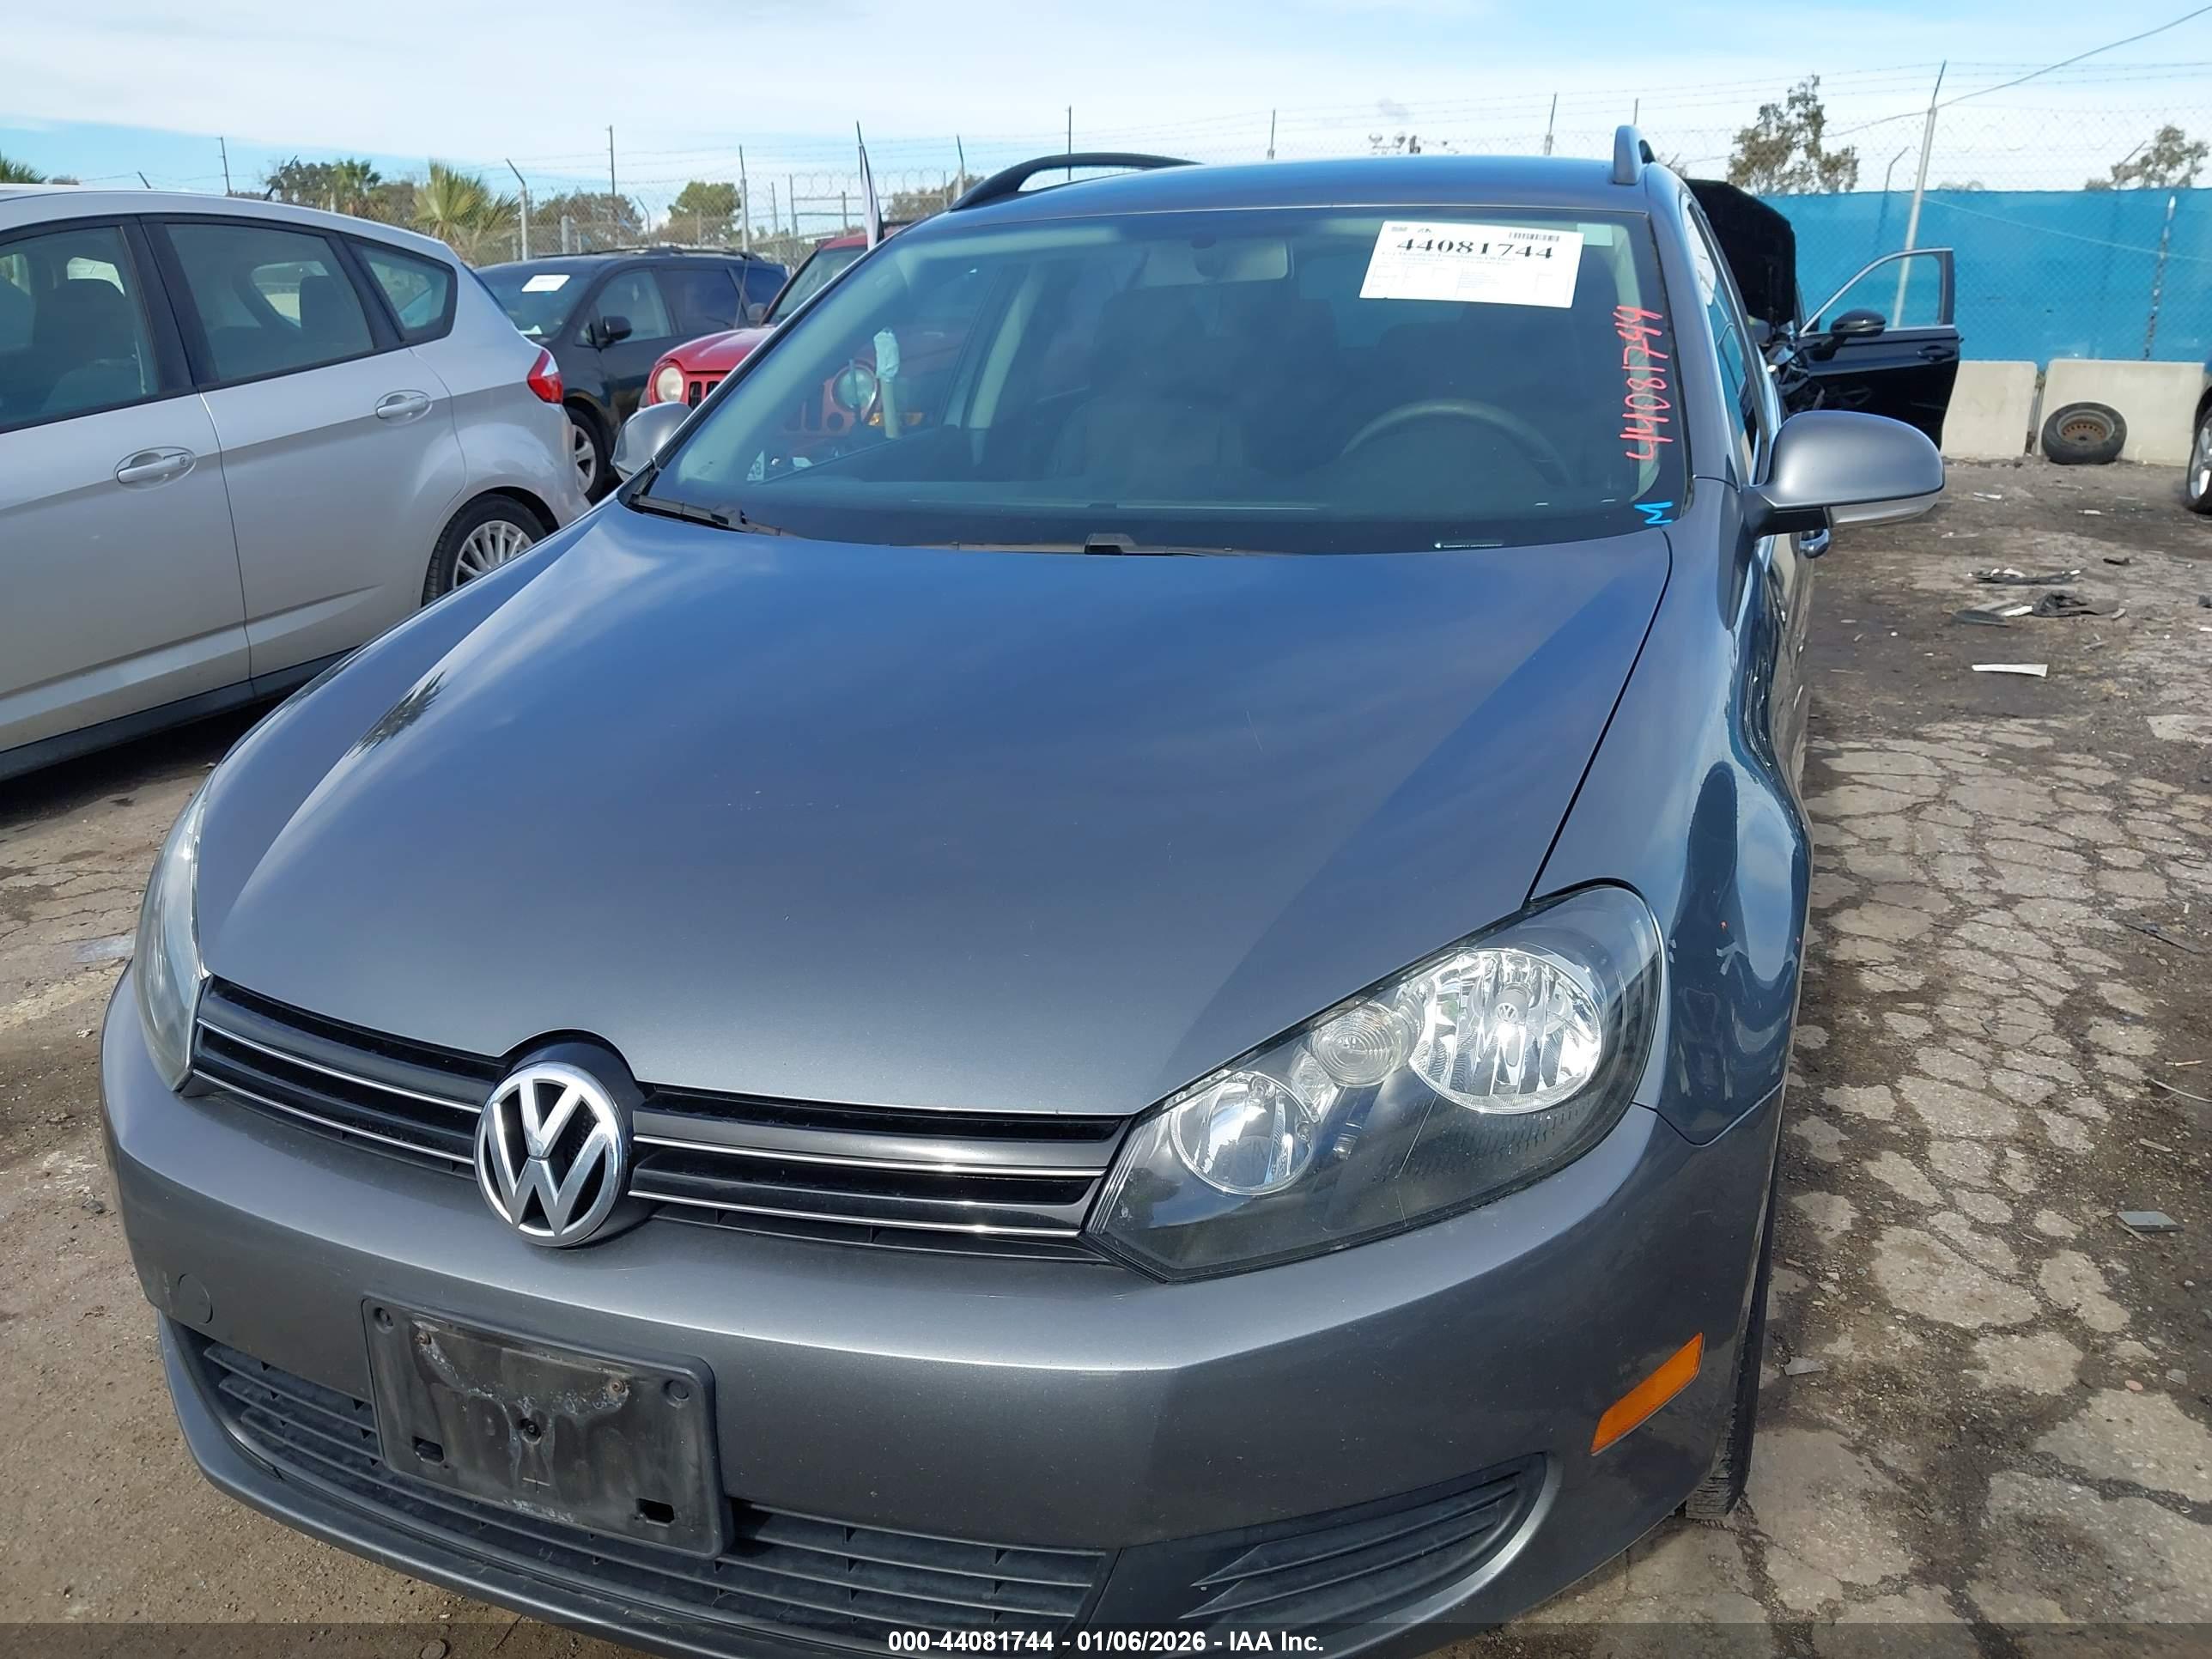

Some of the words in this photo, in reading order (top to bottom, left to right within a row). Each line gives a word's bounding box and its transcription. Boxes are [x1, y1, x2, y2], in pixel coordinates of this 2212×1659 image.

[1396, 239, 1553, 259] 44081744
[1613, 306, 1674, 460] 44081744
[477, 1067, 622, 1243] VW
